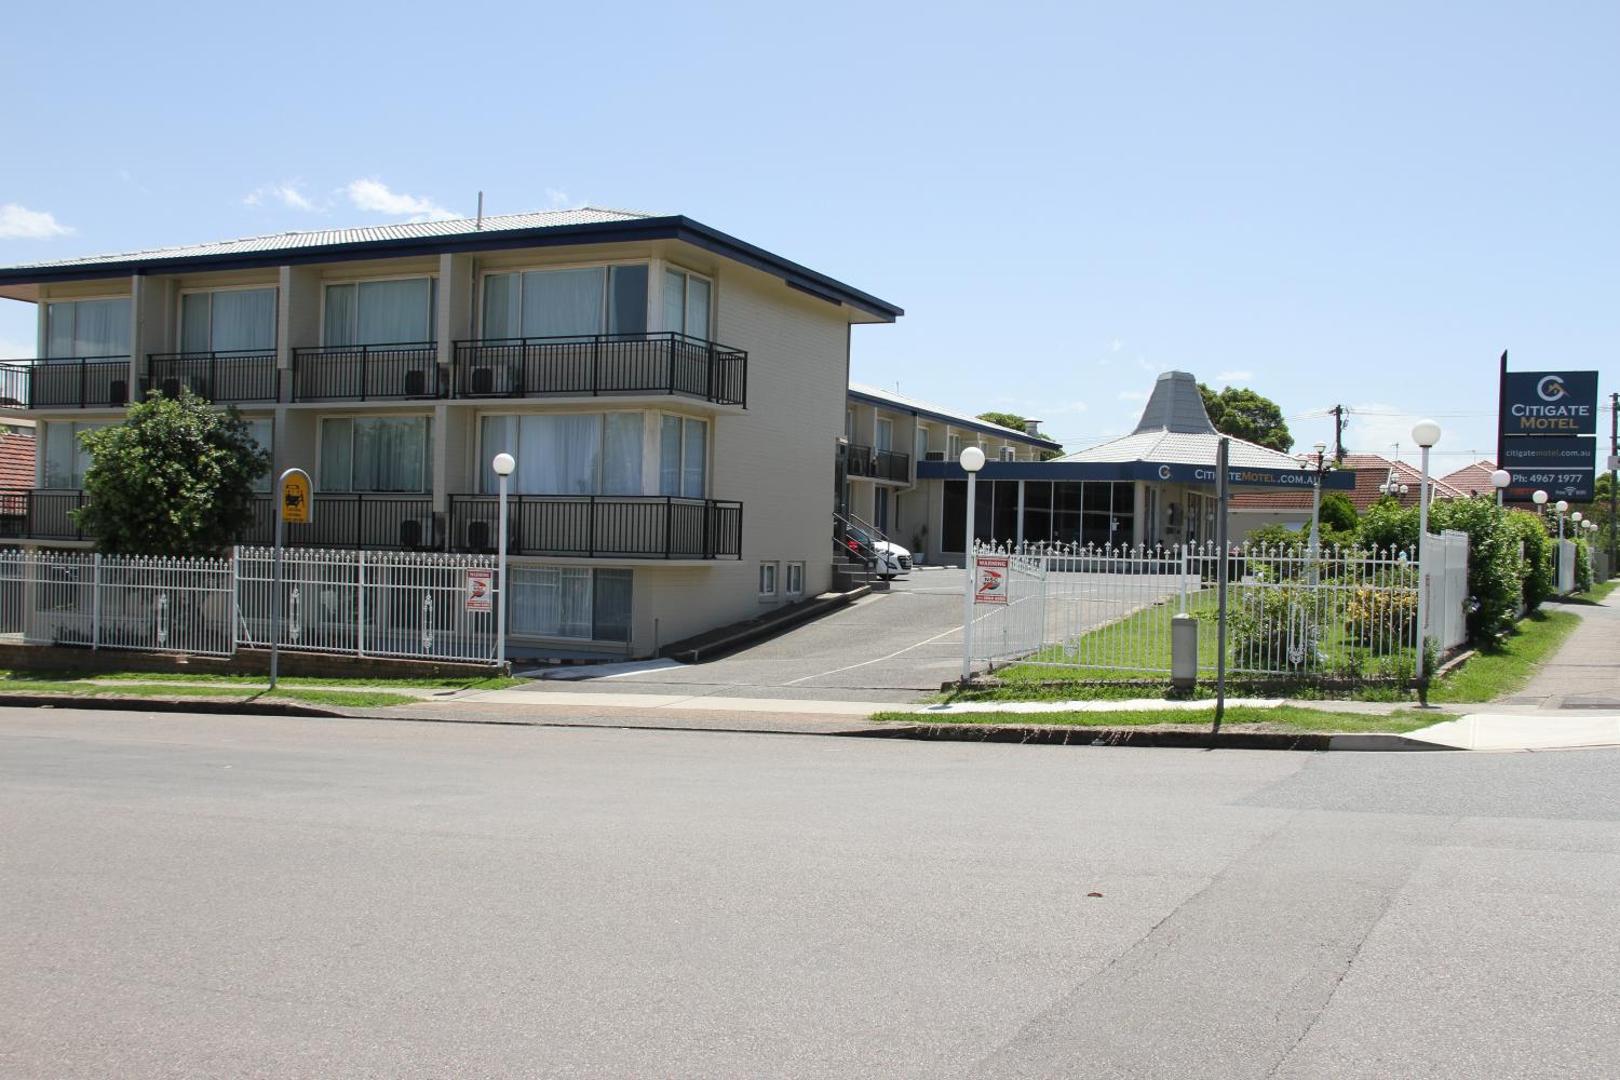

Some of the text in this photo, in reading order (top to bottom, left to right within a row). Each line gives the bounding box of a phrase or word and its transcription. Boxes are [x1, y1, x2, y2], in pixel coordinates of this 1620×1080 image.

[1511, 404, 1590, 417] CITIGATE
[1520, 417, 1580, 429] MOTEL
[1505, 448, 1591, 458] citigatemotel.com.au
[1512, 474, 1583, 483] Ph: 4967 1977
